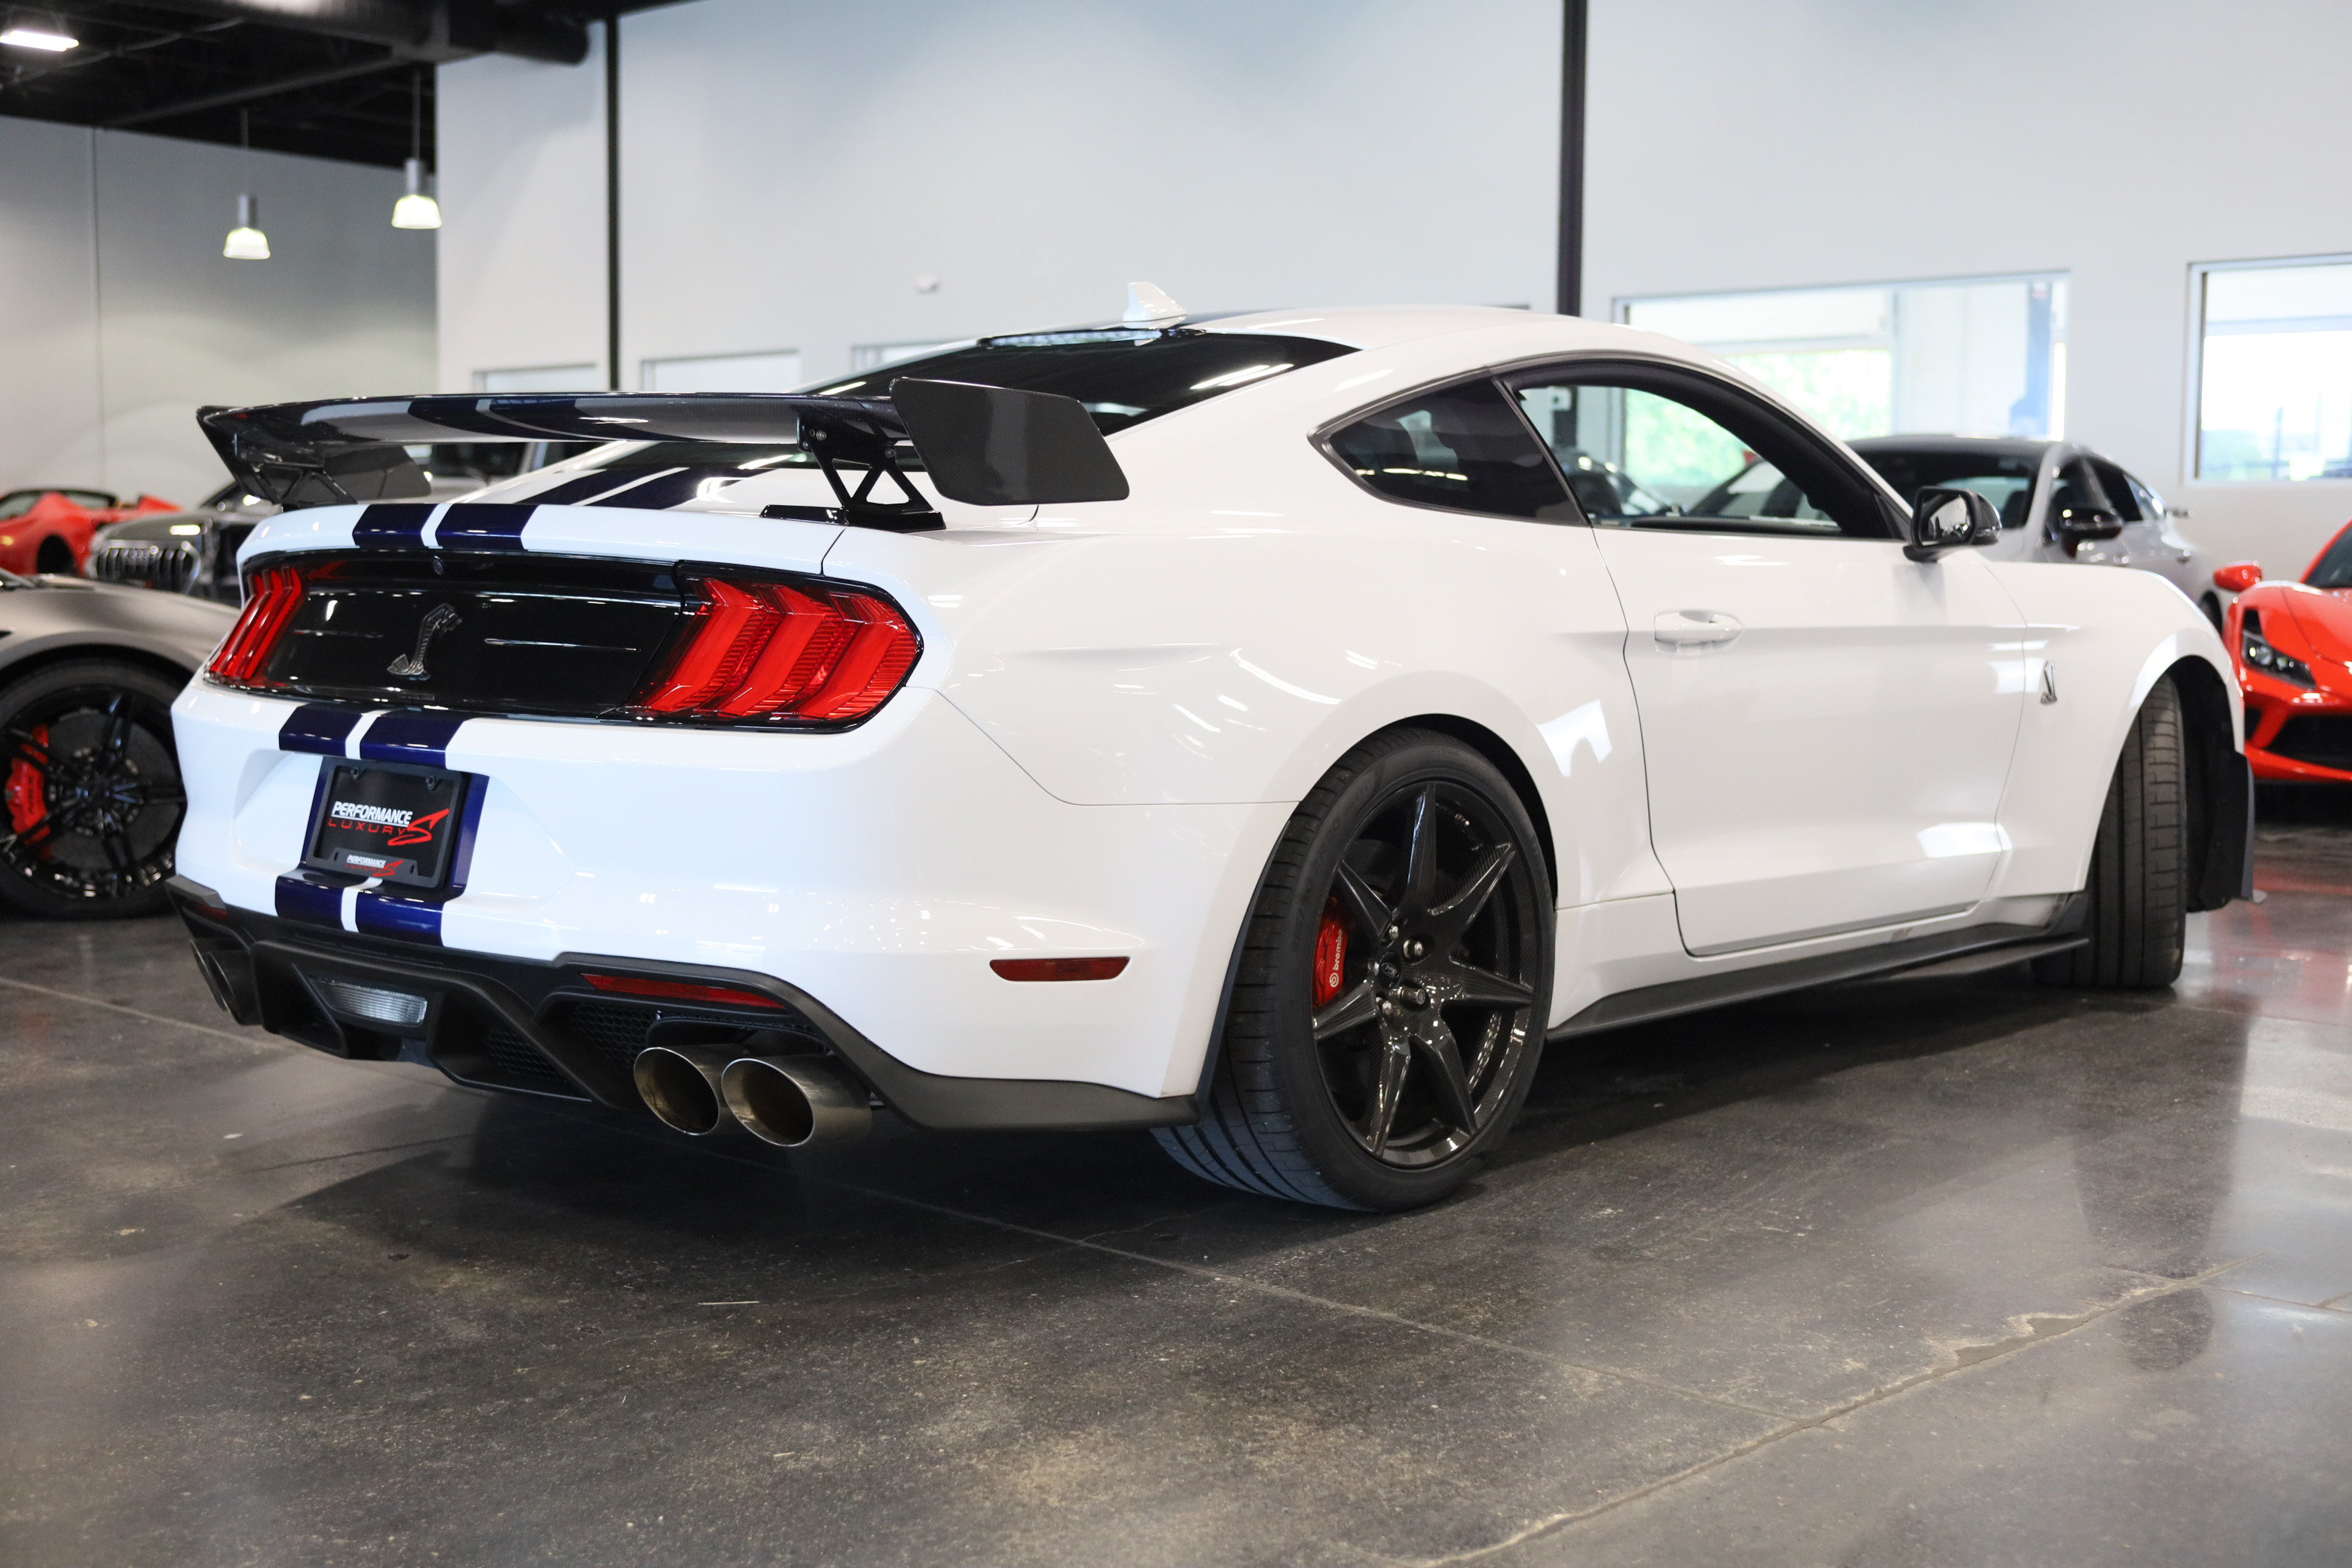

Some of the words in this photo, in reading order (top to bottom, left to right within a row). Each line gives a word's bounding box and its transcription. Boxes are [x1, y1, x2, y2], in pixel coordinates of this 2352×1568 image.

[332, 801, 413, 825] PERFORMANCE
[328, 818, 406, 836] LUXURY
[347, 854, 387, 868] PERFORMANCE
[1333, 929, 1343, 970] brembo
